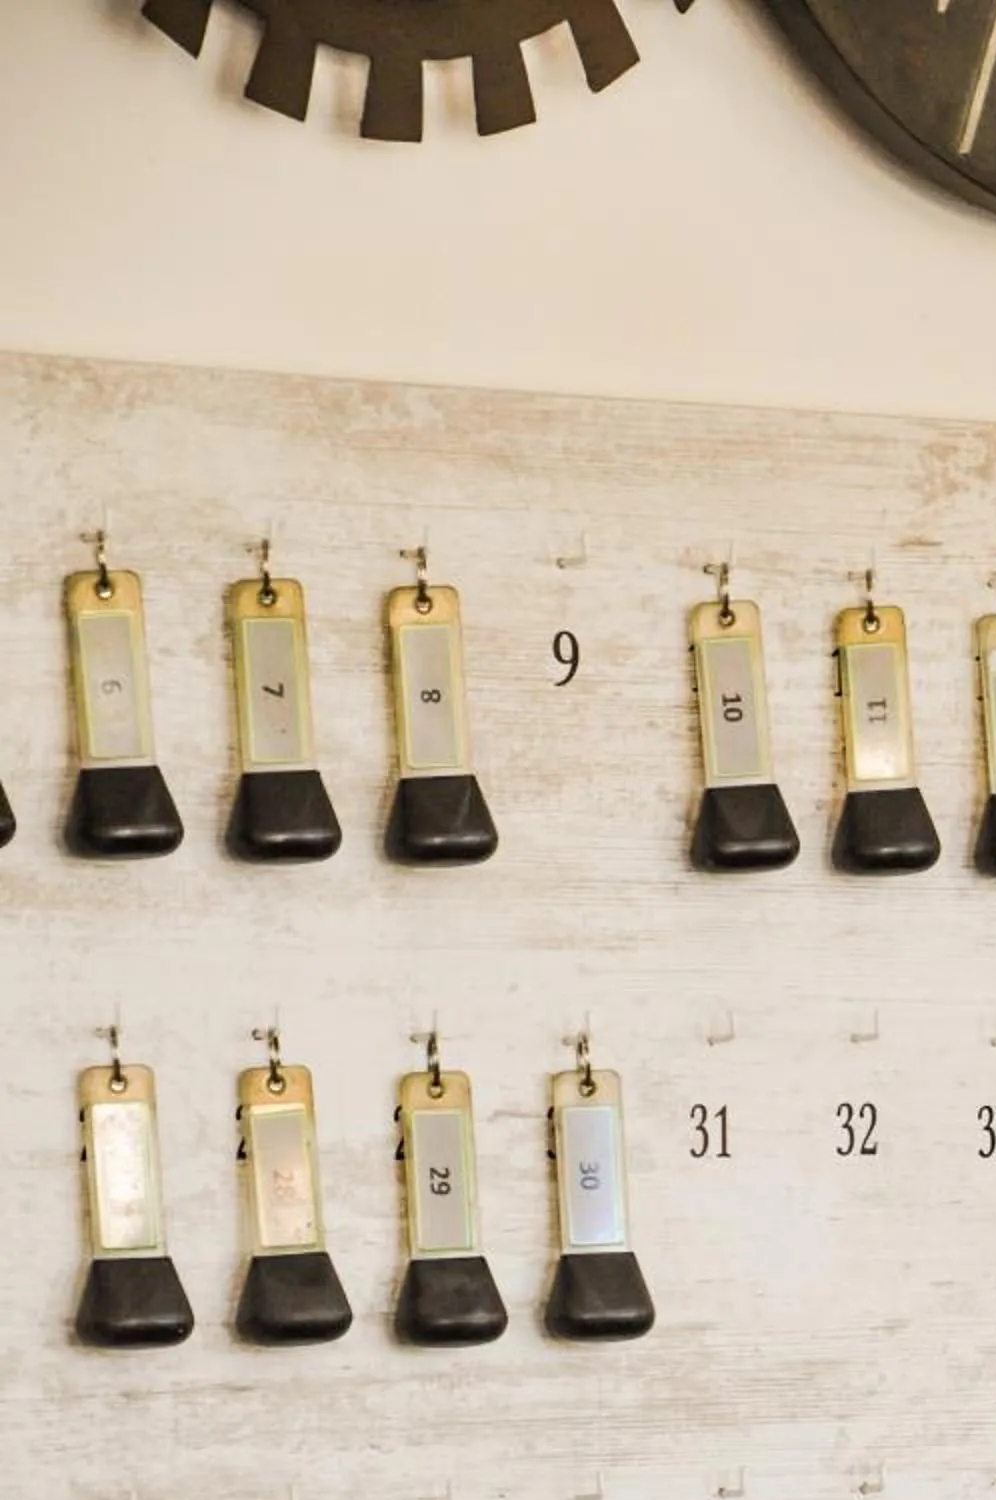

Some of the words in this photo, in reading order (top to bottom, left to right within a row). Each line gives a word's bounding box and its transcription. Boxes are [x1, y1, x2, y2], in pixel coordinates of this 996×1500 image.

[552, 630, 580, 687] 9
[262, 682, 285, 699] 7
[420, 688, 442, 704] 8
[721, 693, 744, 723] 10
[866, 698, 888, 724] 11
[689, 1103, 731, 1159] 31
[836, 1103, 878, 1157] 32
[429, 1167, 452, 1196] 29
[578, 1161, 602, 1191] 30
